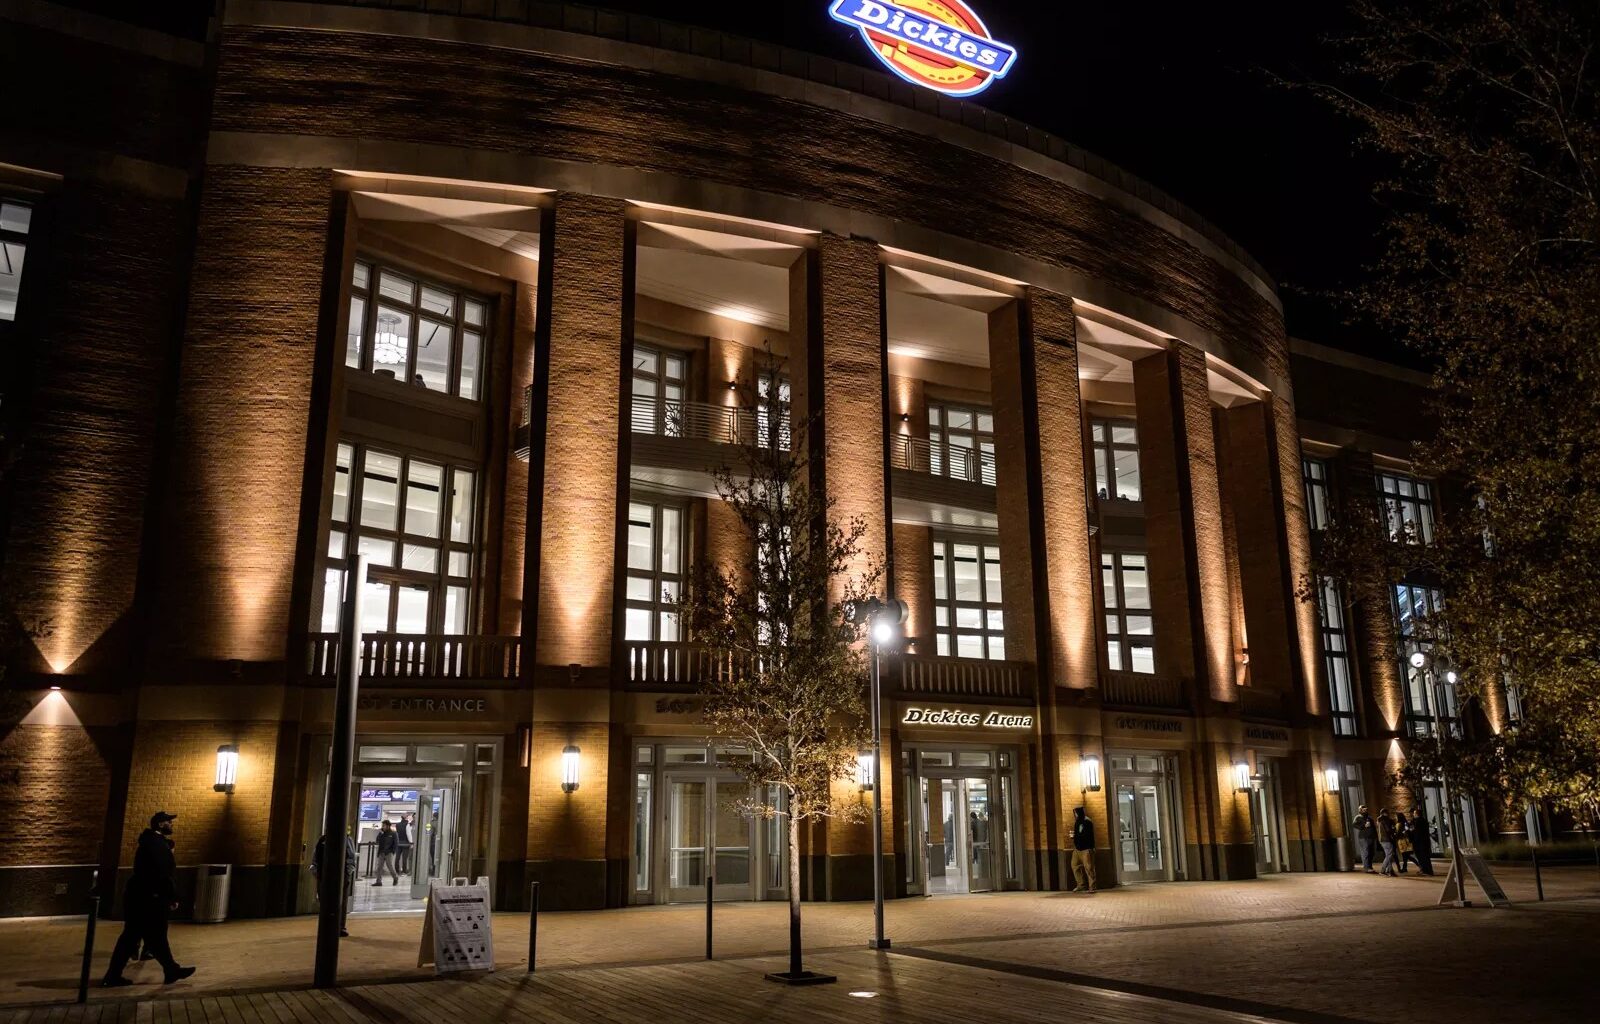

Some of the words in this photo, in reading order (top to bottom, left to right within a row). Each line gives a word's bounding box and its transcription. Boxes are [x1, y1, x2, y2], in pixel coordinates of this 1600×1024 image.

[853, 0, 998, 65] Dickies
[389, 698, 484, 712] ENTRANCE
[902, 707, 981, 725] Dickies
[983, 712, 1033, 728] Arena
